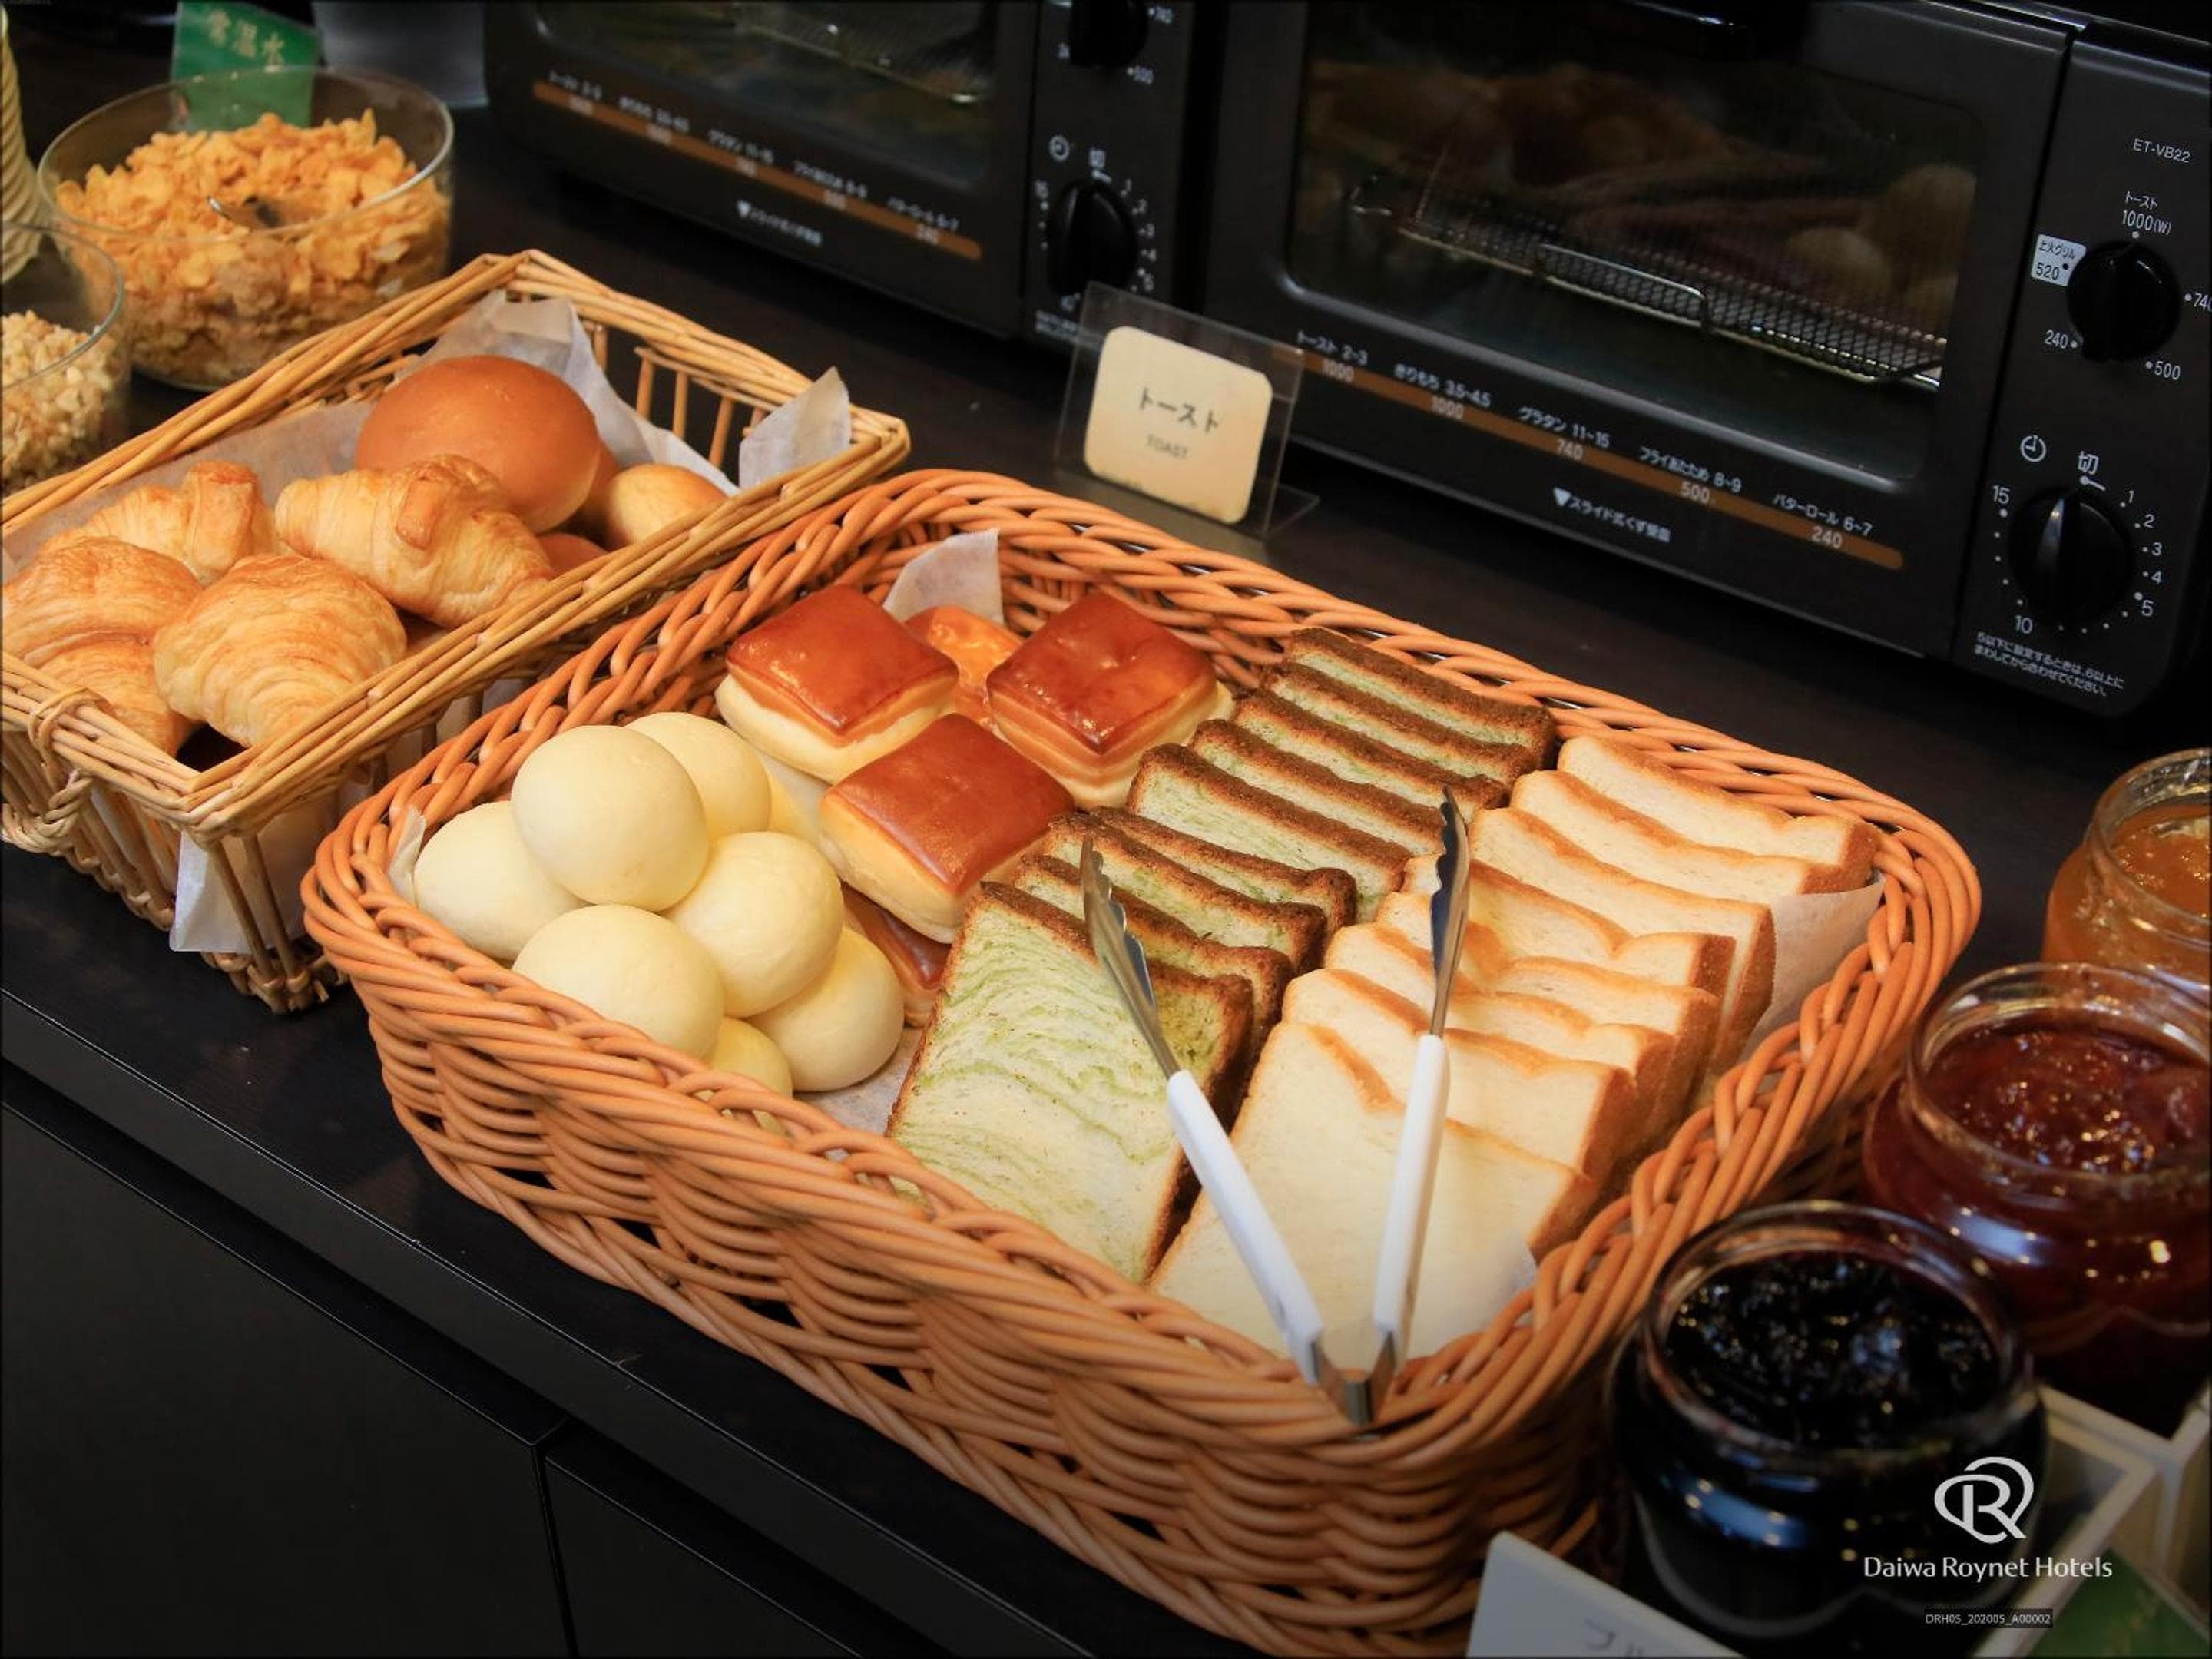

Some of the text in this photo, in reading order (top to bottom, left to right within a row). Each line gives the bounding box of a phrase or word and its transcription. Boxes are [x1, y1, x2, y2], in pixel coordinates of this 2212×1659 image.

[2133, 138, 2191, 163] ET-VB22
[2125, 190, 2158, 210] トースト
[2036, 263, 2059, 280] 520
[1296, 330, 1337, 353] トースト
[2044, 329, 2068, 349] 240
[2154, 360, 2181, 381] 500
[1139, 387, 1218, 433] トースト
[1147, 433, 1188, 459] TOAST
[2077, 450, 2100, 475] 切
[1679, 481, 1710, 505] 500
[1992, 485, 2011, 505] 15
[2128, 489, 2135, 504] 1
[1773, 493, 1839, 525] バターロール
[2144, 512, 2154, 529] 2
[1811, 525, 1843, 550] 240
[2152, 541, 2163, 556] 3
[2151, 571, 2162, 584] 4
[2141, 600, 2154, 617] 5
[2015, 614, 2033, 634] 10
